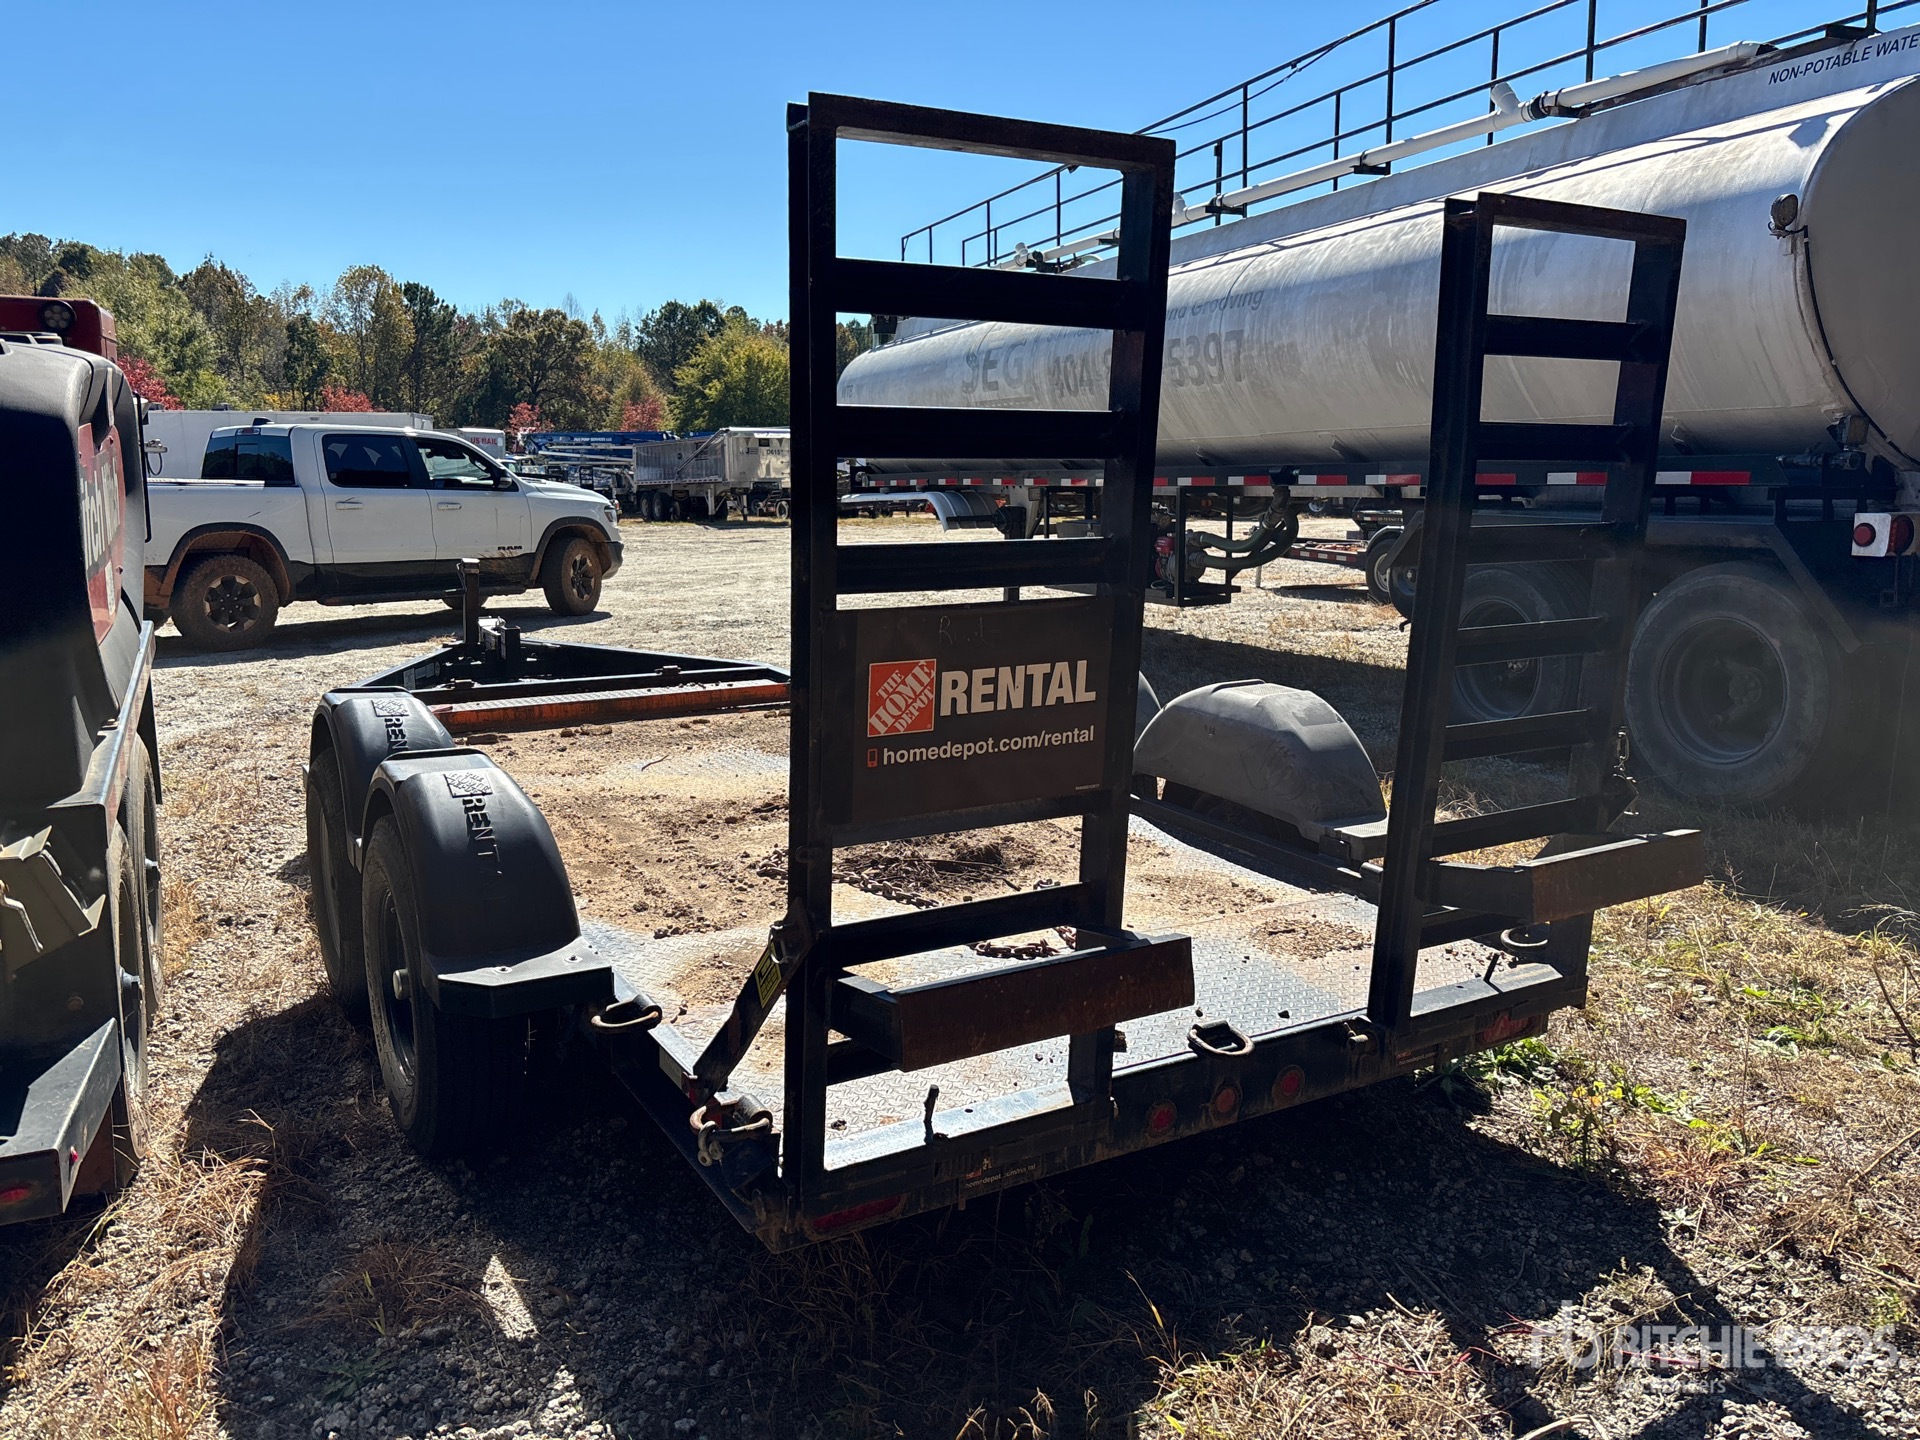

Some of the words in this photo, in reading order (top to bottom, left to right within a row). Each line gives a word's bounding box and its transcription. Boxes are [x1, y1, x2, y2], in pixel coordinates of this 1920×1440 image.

[1768, 46, 1872, 85] NON-POTABLE
[1876, 33, 1920, 57] WATE
[1191, 289, 1265, 317] Grooving
[961, 341, 1026, 394] SEG
[1166, 329, 1245, 387] 5397
[481, 437, 497, 445] MAIL
[79, 471, 107, 571] itch
[869, 661, 935, 735] HOME
[876, 669, 904, 700] THE
[939, 659, 1096, 717] RENTAL
[893, 686, 934, 733] DEPOT
[384, 717, 409, 751] REN
[883, 725, 1094, 766] homedepot.com/rental
